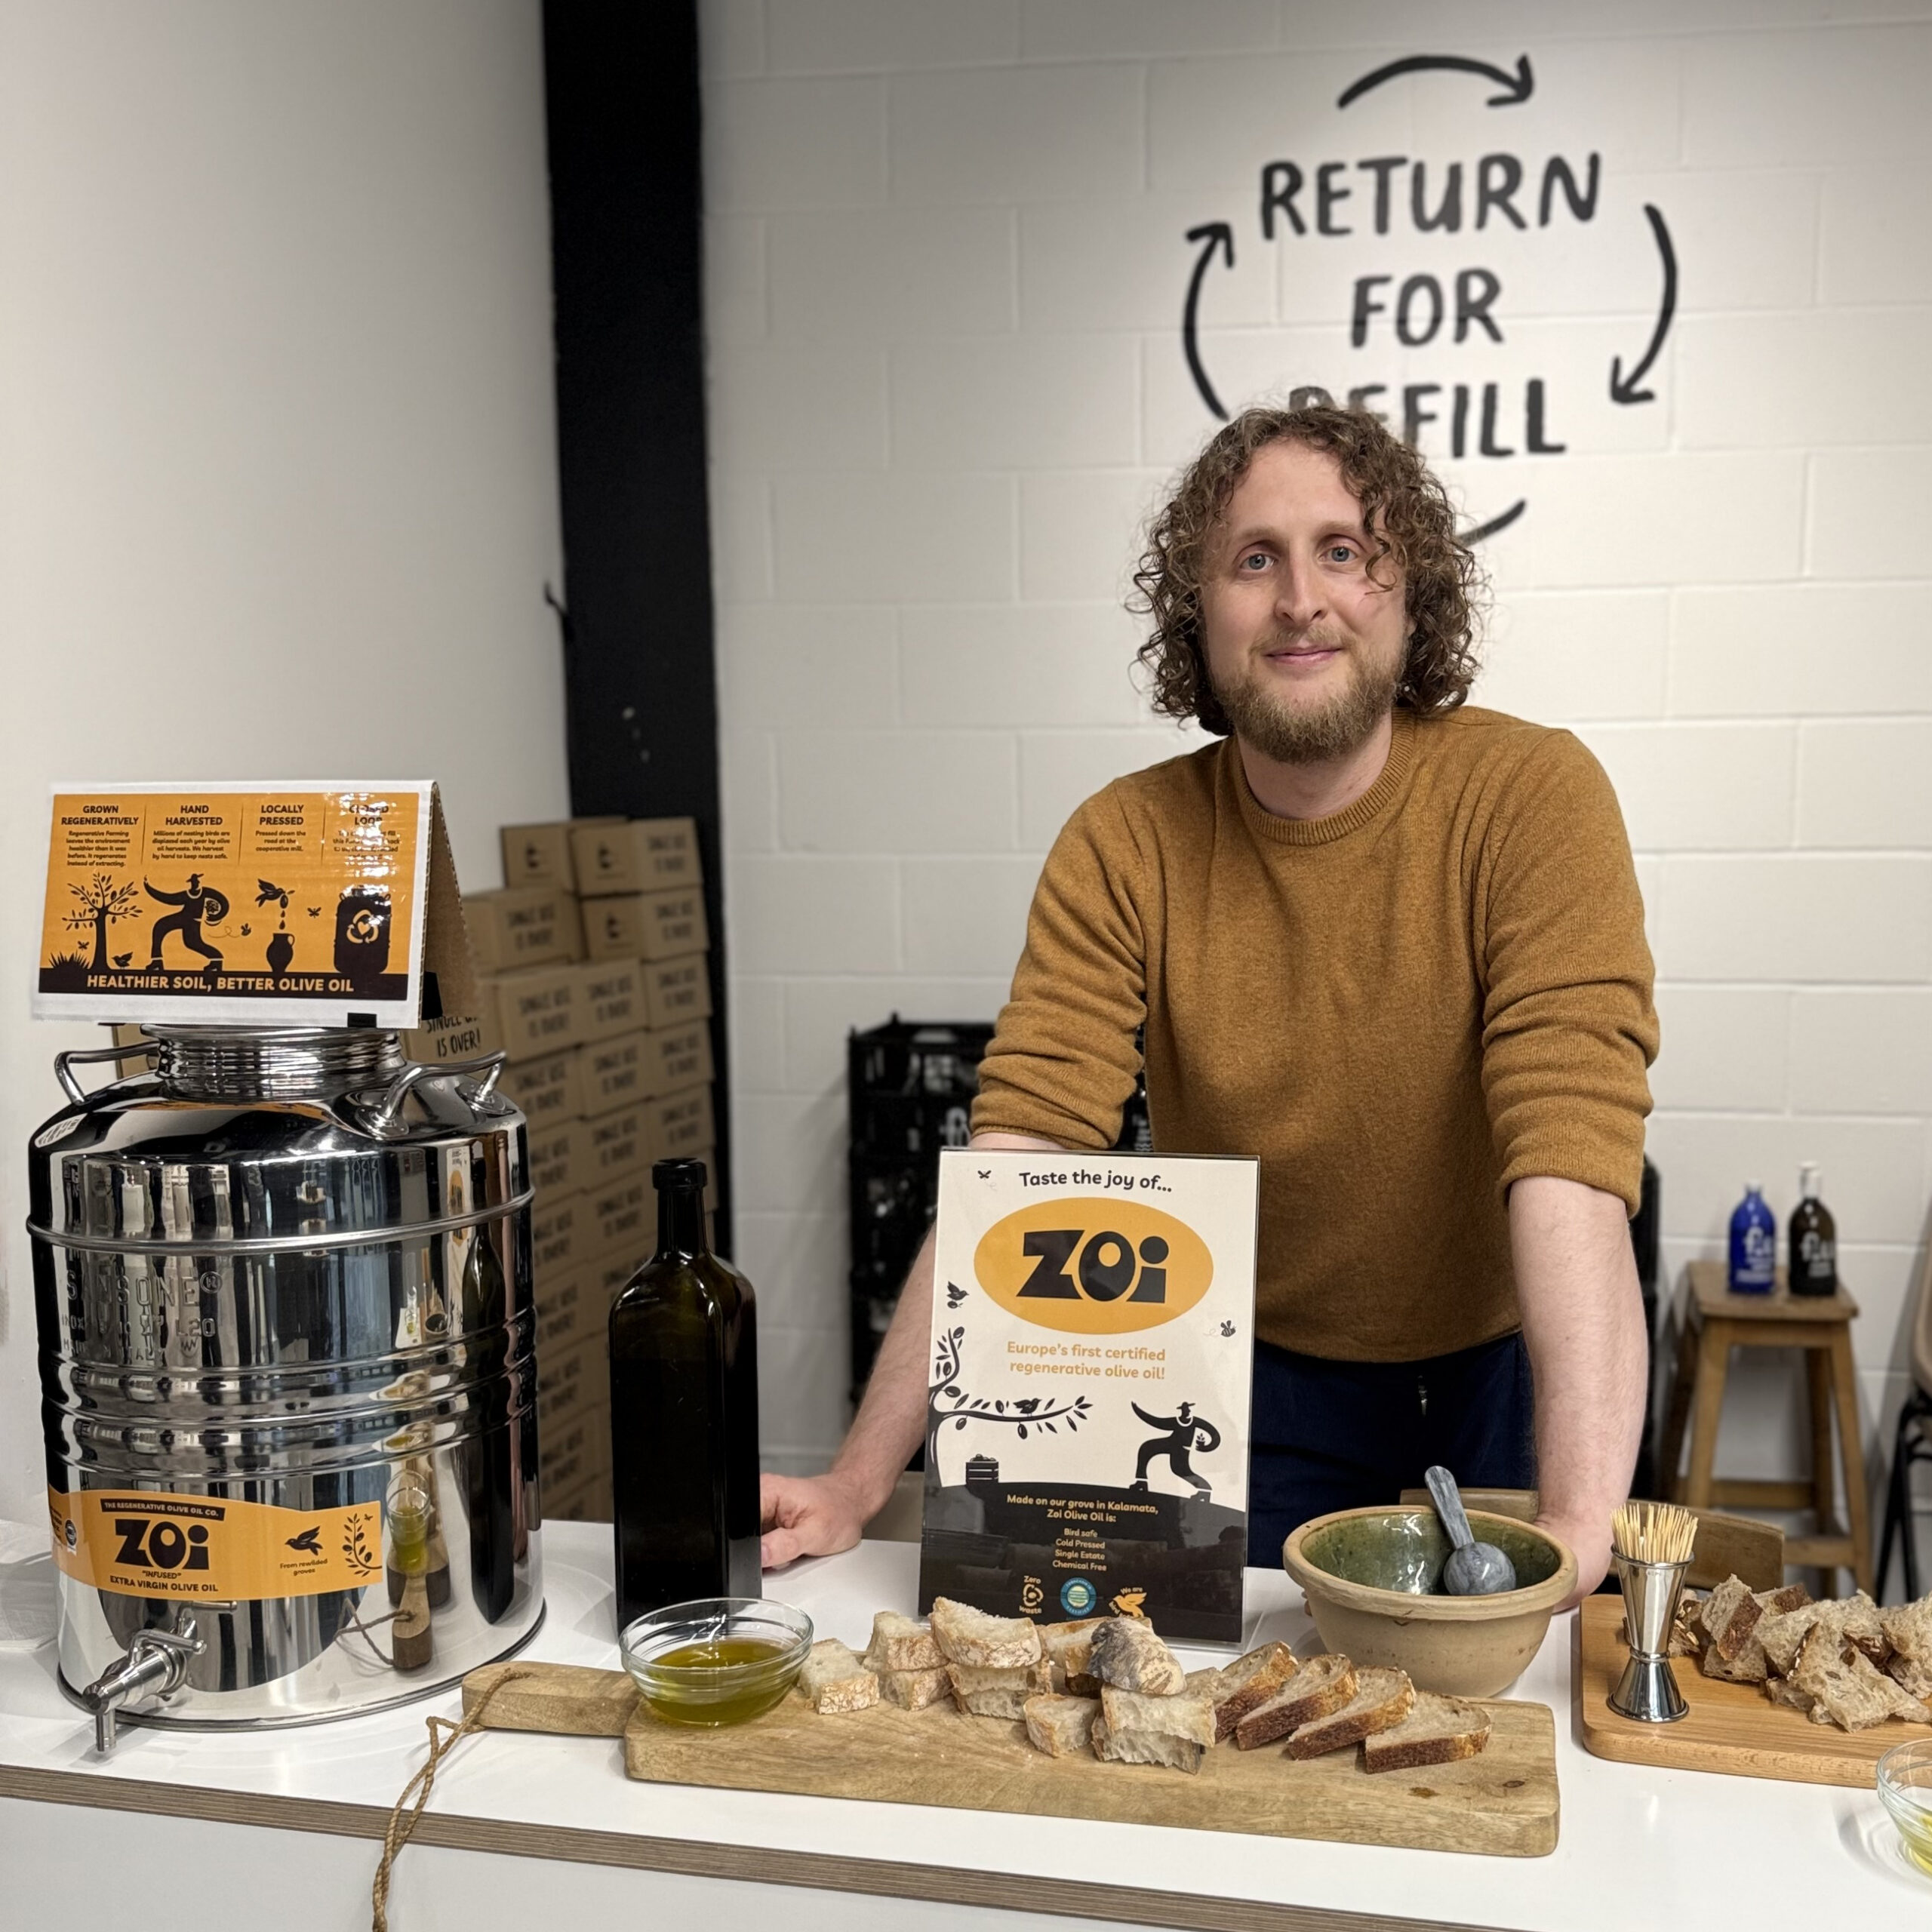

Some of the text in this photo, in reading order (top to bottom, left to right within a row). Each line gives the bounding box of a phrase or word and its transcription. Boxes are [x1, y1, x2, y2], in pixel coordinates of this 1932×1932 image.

[1260, 151, 1600, 241] RETURN
[1351, 267, 1504, 349] FOR
[83, 805, 118, 814] GROWN
[180, 804, 209, 814] HAND
[260, 804, 304, 814] LOCALLY
[61, 817, 139, 826] REGENERATIVELY
[165, 817, 223, 826] HARVESTED
[260, 817, 304, 825] PRESSED
[87, 974, 355, 992] HEALTHIER SOIL, BETTER OLIVE OIL
[437, 1027, 481, 1058] IS OVER!
[1019, 1169, 1172, 1192] Taste the joy of...
[1072, 1344, 1101, 1358] first
[1105, 1346, 1165, 1361] certified
[1010, 1361, 1165, 1380] regenerative olive oil!
[117, 1502, 166, 1511] REGENERATIVE
[167, 1505, 189, 1513] OLIVE
[205, 1509, 219, 1517] CO.
[1007, 1494, 1033, 1504] Made
[1068, 1500, 1094, 1509] grove
[1097, 1500, 1106, 1509] in
[1108, 1501, 1158, 1515] Kalamata,
[1047, 1509, 1116, 1522] Zoi Olive Oil is:
[1064, 1528, 1097, 1537] Bird safe
[1075, 1540, 1105, 1549] Pressed
[1055, 1549, 1105, 1560] Single Estate
[299, 1558, 328, 1567] rewilded
[1053, 1560, 1106, 1571] Chemical Free
[110, 1576, 135, 1586] EXTRA
[137, 1580, 168, 1590] VIRGIN
[171, 1583, 199, 1592] OLIVE
[1024, 1576, 1041, 1584] Zero
[1019, 1606, 1042, 1614] waste
